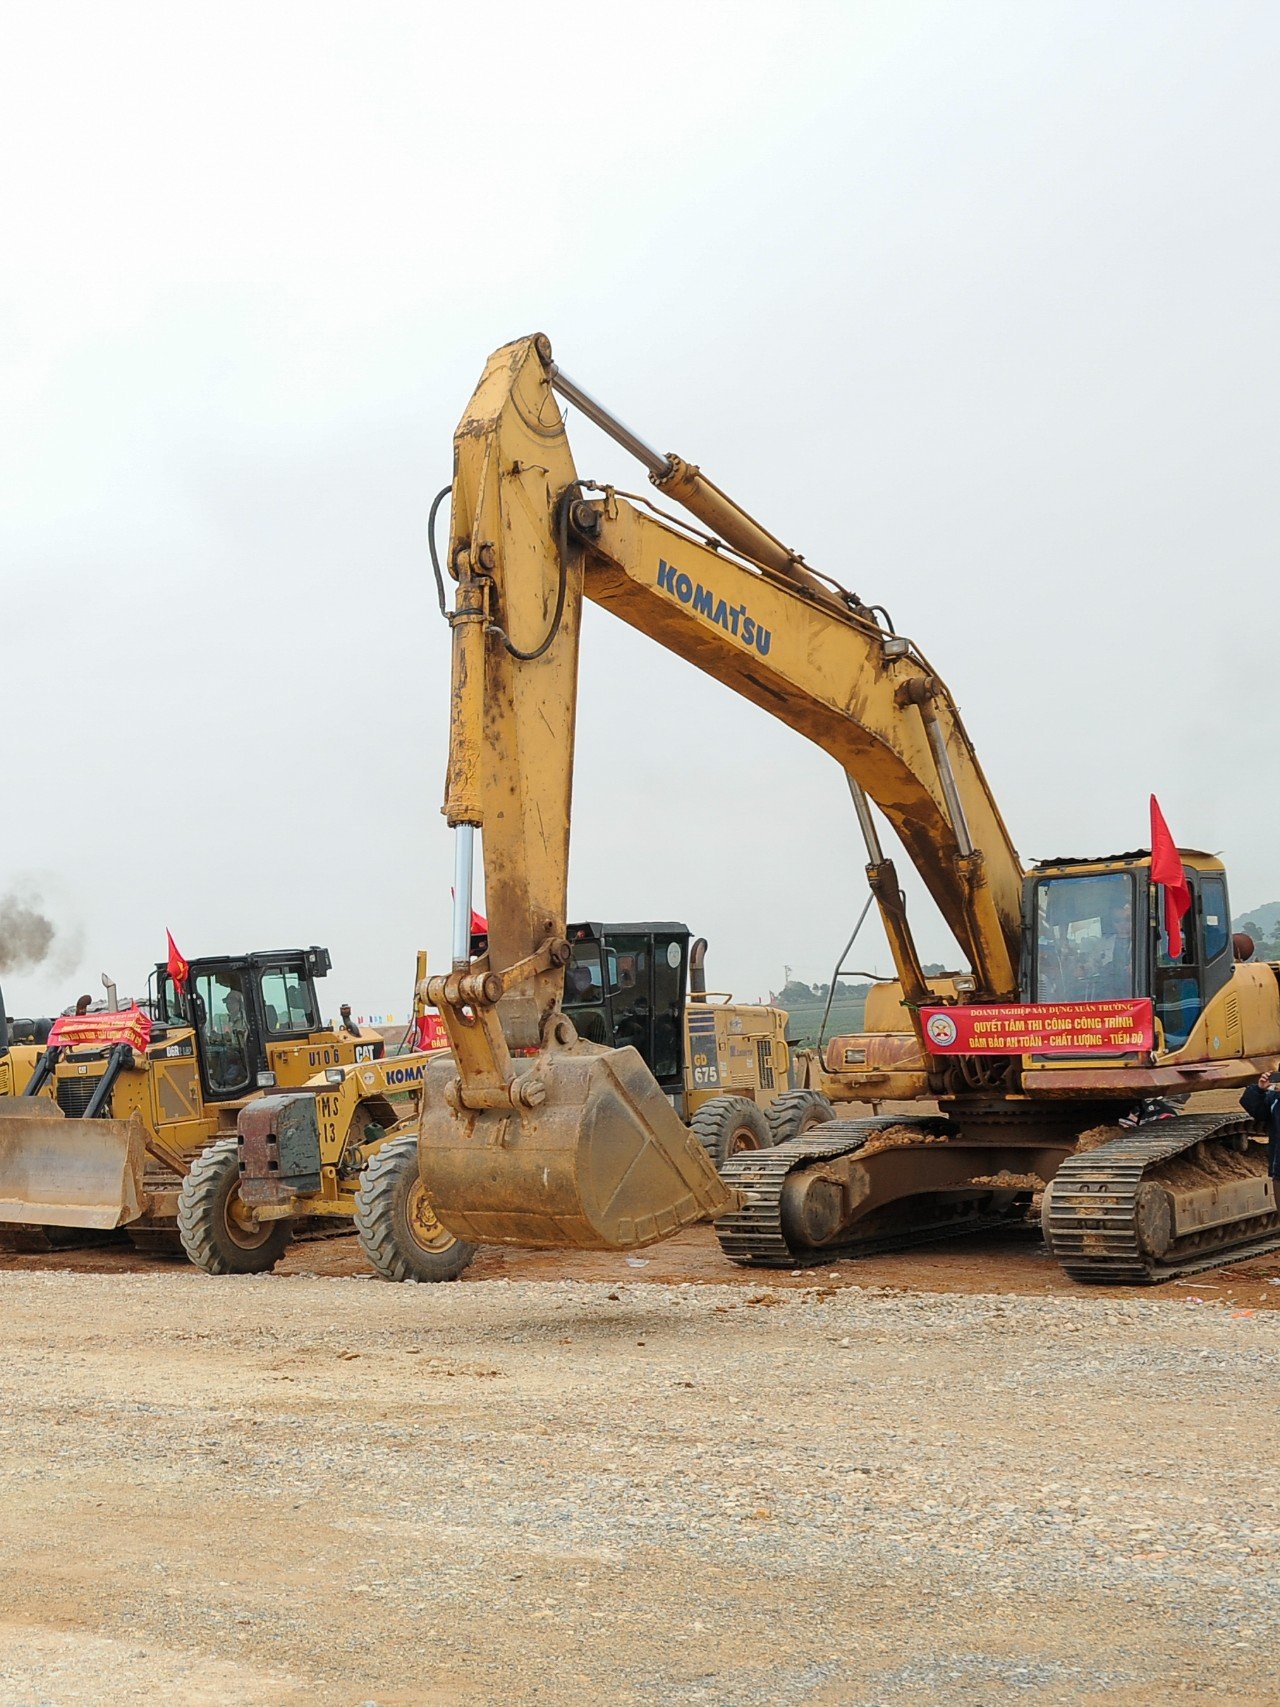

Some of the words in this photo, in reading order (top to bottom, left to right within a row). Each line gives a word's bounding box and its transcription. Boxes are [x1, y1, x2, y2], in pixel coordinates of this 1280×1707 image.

[656, 557, 772, 656] KOMATSU
[970, 1009, 999, 1017] DOANH
[1000, 1006, 1031, 1017] NGHIỆP
[1032, 1005, 1048, 1015] XÂY
[1049, 1005, 1073, 1015] DỰNG
[1074, 1003, 1096, 1013] XUÂN
[1098, 1002, 1134, 1012] TRƯỜNG
[974, 1018, 1002, 1034] QUYẾT
[1004, 1018, 1025, 1032] TÂM
[1027, 1019, 1042, 1031] THI
[1045, 1016, 1072, 1030] CÔNG
[1074, 1016, 1102, 1029] CÔNG
[1104, 1015, 1134, 1029] TRÌNH
[969, 1035, 987, 1048] ĐẢM
[988, 1034, 1004, 1048] BẢO
[1006, 1036, 1018, 1047] AN
[1019, 1034, 1042, 1047] TOÀN
[1049, 1032, 1073, 1046] CHẤT
[1074, 1034, 1103, 1048] LƯỢNG
[1110, 1031, 1130, 1045] TIẾN
[1130, 1031, 1144, 1046] ĐỘ
[355, 1045, 375, 1063] CAT
[694, 1053, 708, 1066] GD
[386, 1064, 427, 1086] KOMA
[694, 1066, 718, 1083] 675
[321, 1096, 339, 1118] MS
